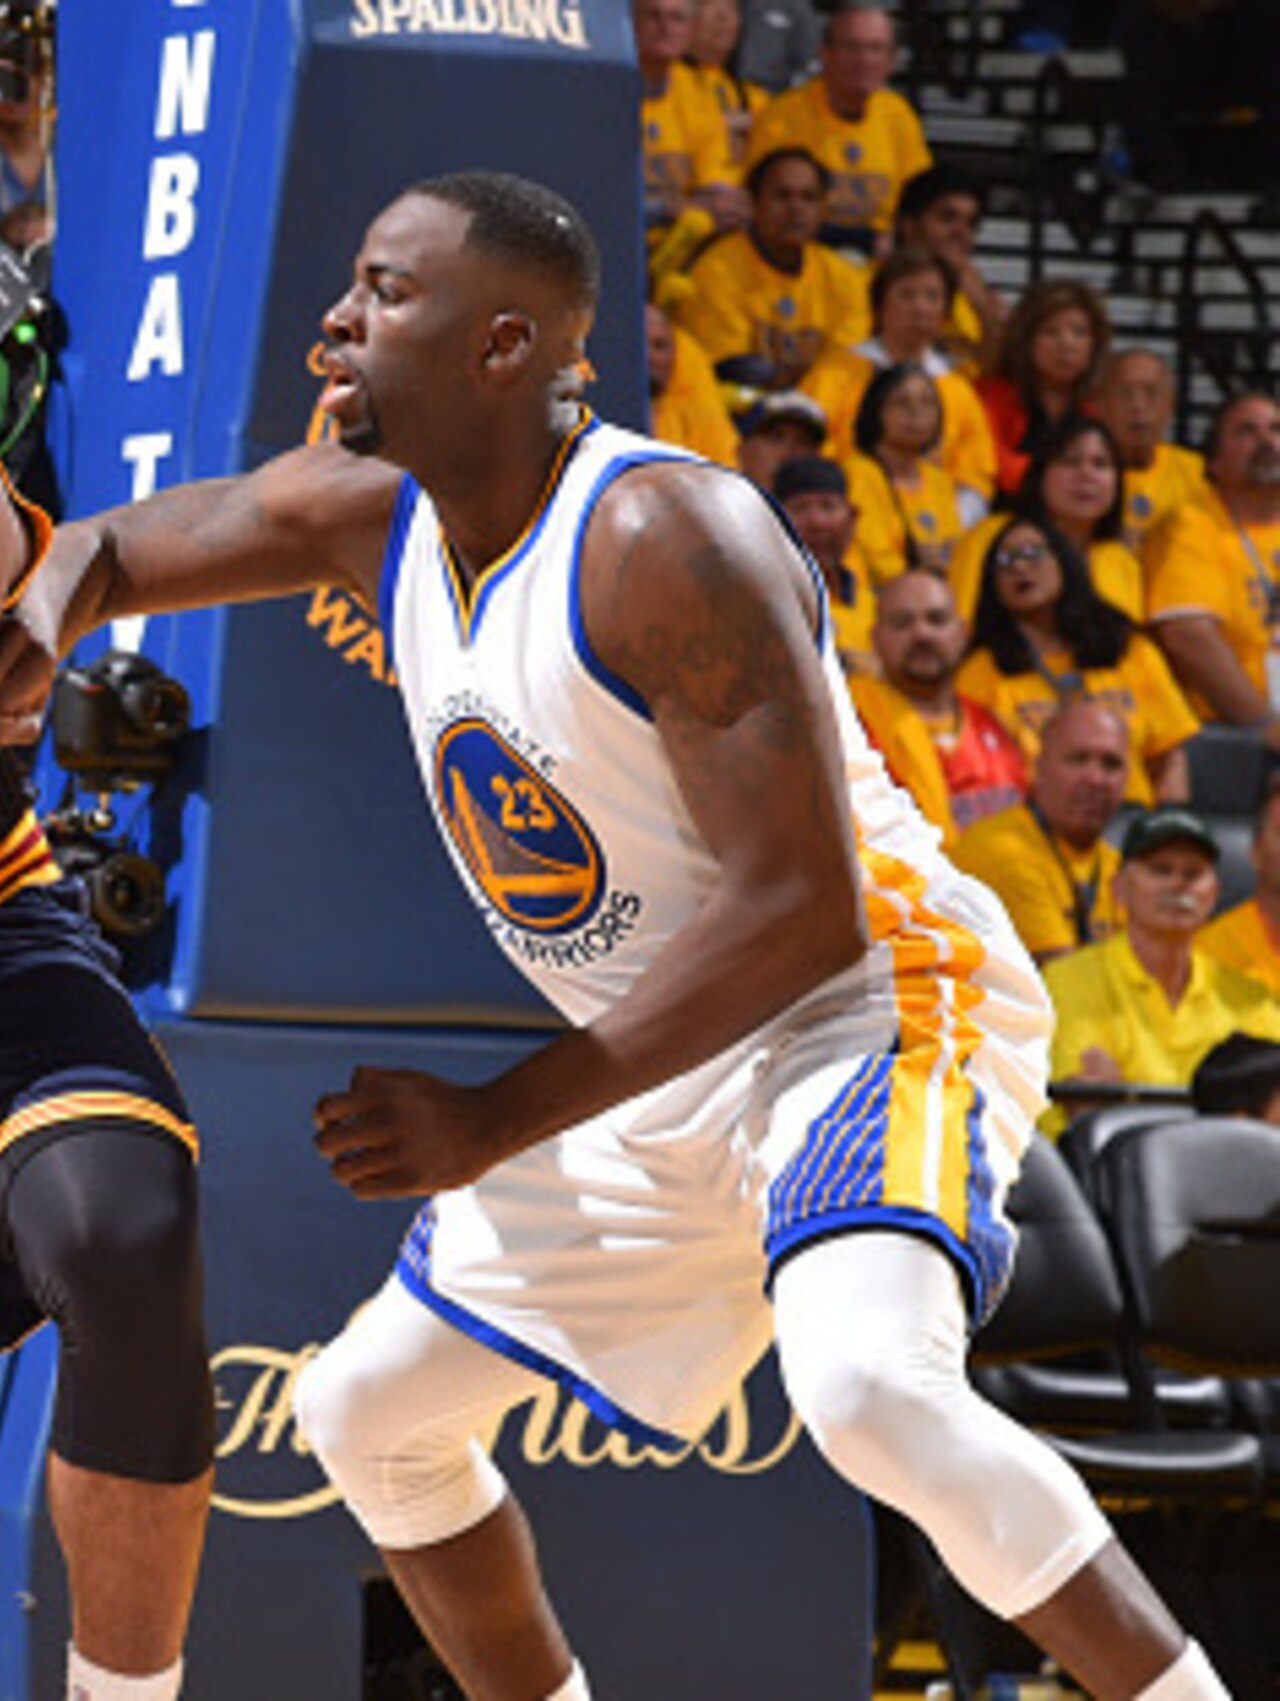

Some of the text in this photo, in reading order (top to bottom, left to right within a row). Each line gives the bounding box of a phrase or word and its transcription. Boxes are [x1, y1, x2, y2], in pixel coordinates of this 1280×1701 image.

[126, 28, 216, 382] NBA
[306, 585, 400, 686] WA
[490, 773, 558, 832] 23
